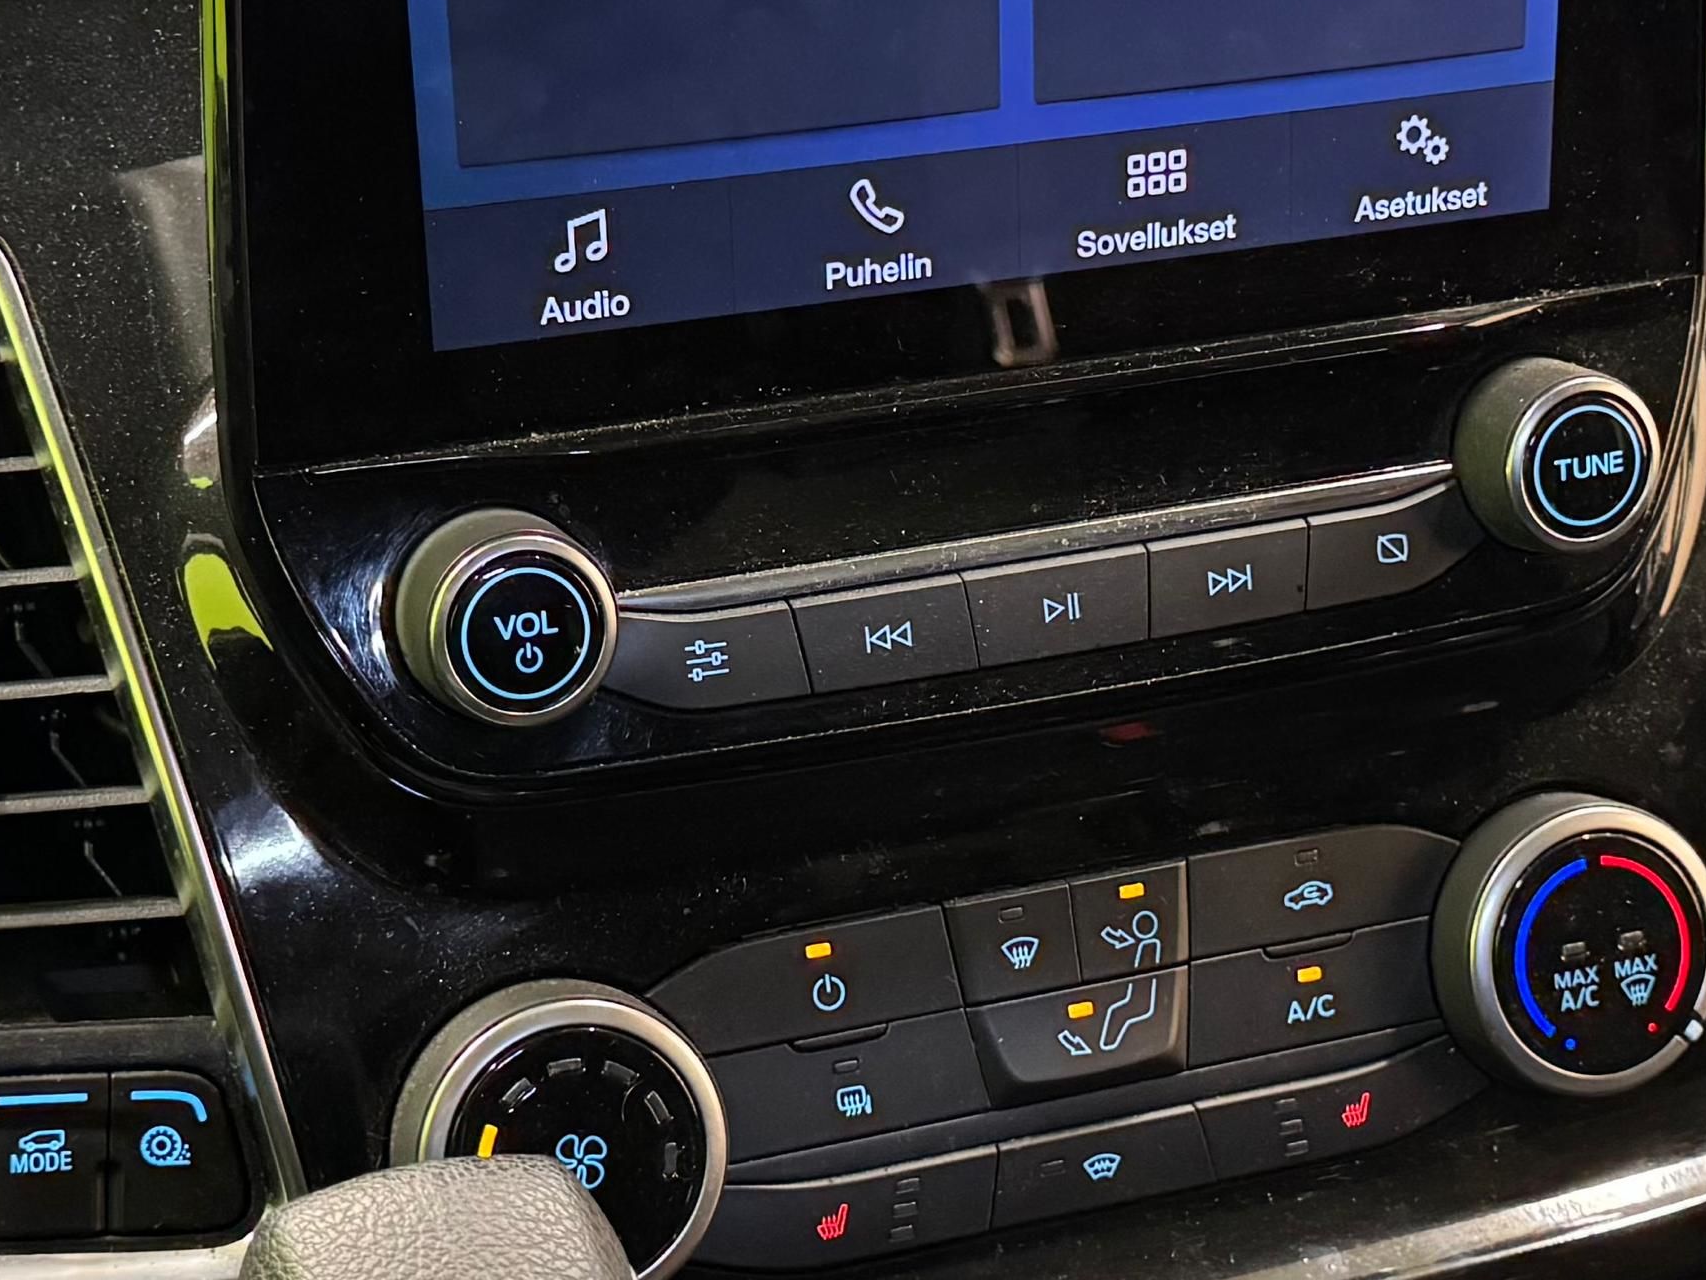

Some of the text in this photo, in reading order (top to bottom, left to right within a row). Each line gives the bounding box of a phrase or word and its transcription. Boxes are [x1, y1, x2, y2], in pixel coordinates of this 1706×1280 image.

[1353, 181, 1488, 223] Asetukset
[1076, 213, 1237, 260] Sovellukset
[825, 251, 933, 290] Puhelin
[540, 289, 631, 326] Audio
[1554, 446, 1625, 481] TUNE
[493, 611, 559, 642] VOL
[1553, 965, 1600, 990] MAX
[1613, 953, 1658, 979] MAX
[1287, 994, 1336, 1024] A/C
[1560, 985, 1600, 1012] A/C
[9, 1151, 73, 1175] MODE
